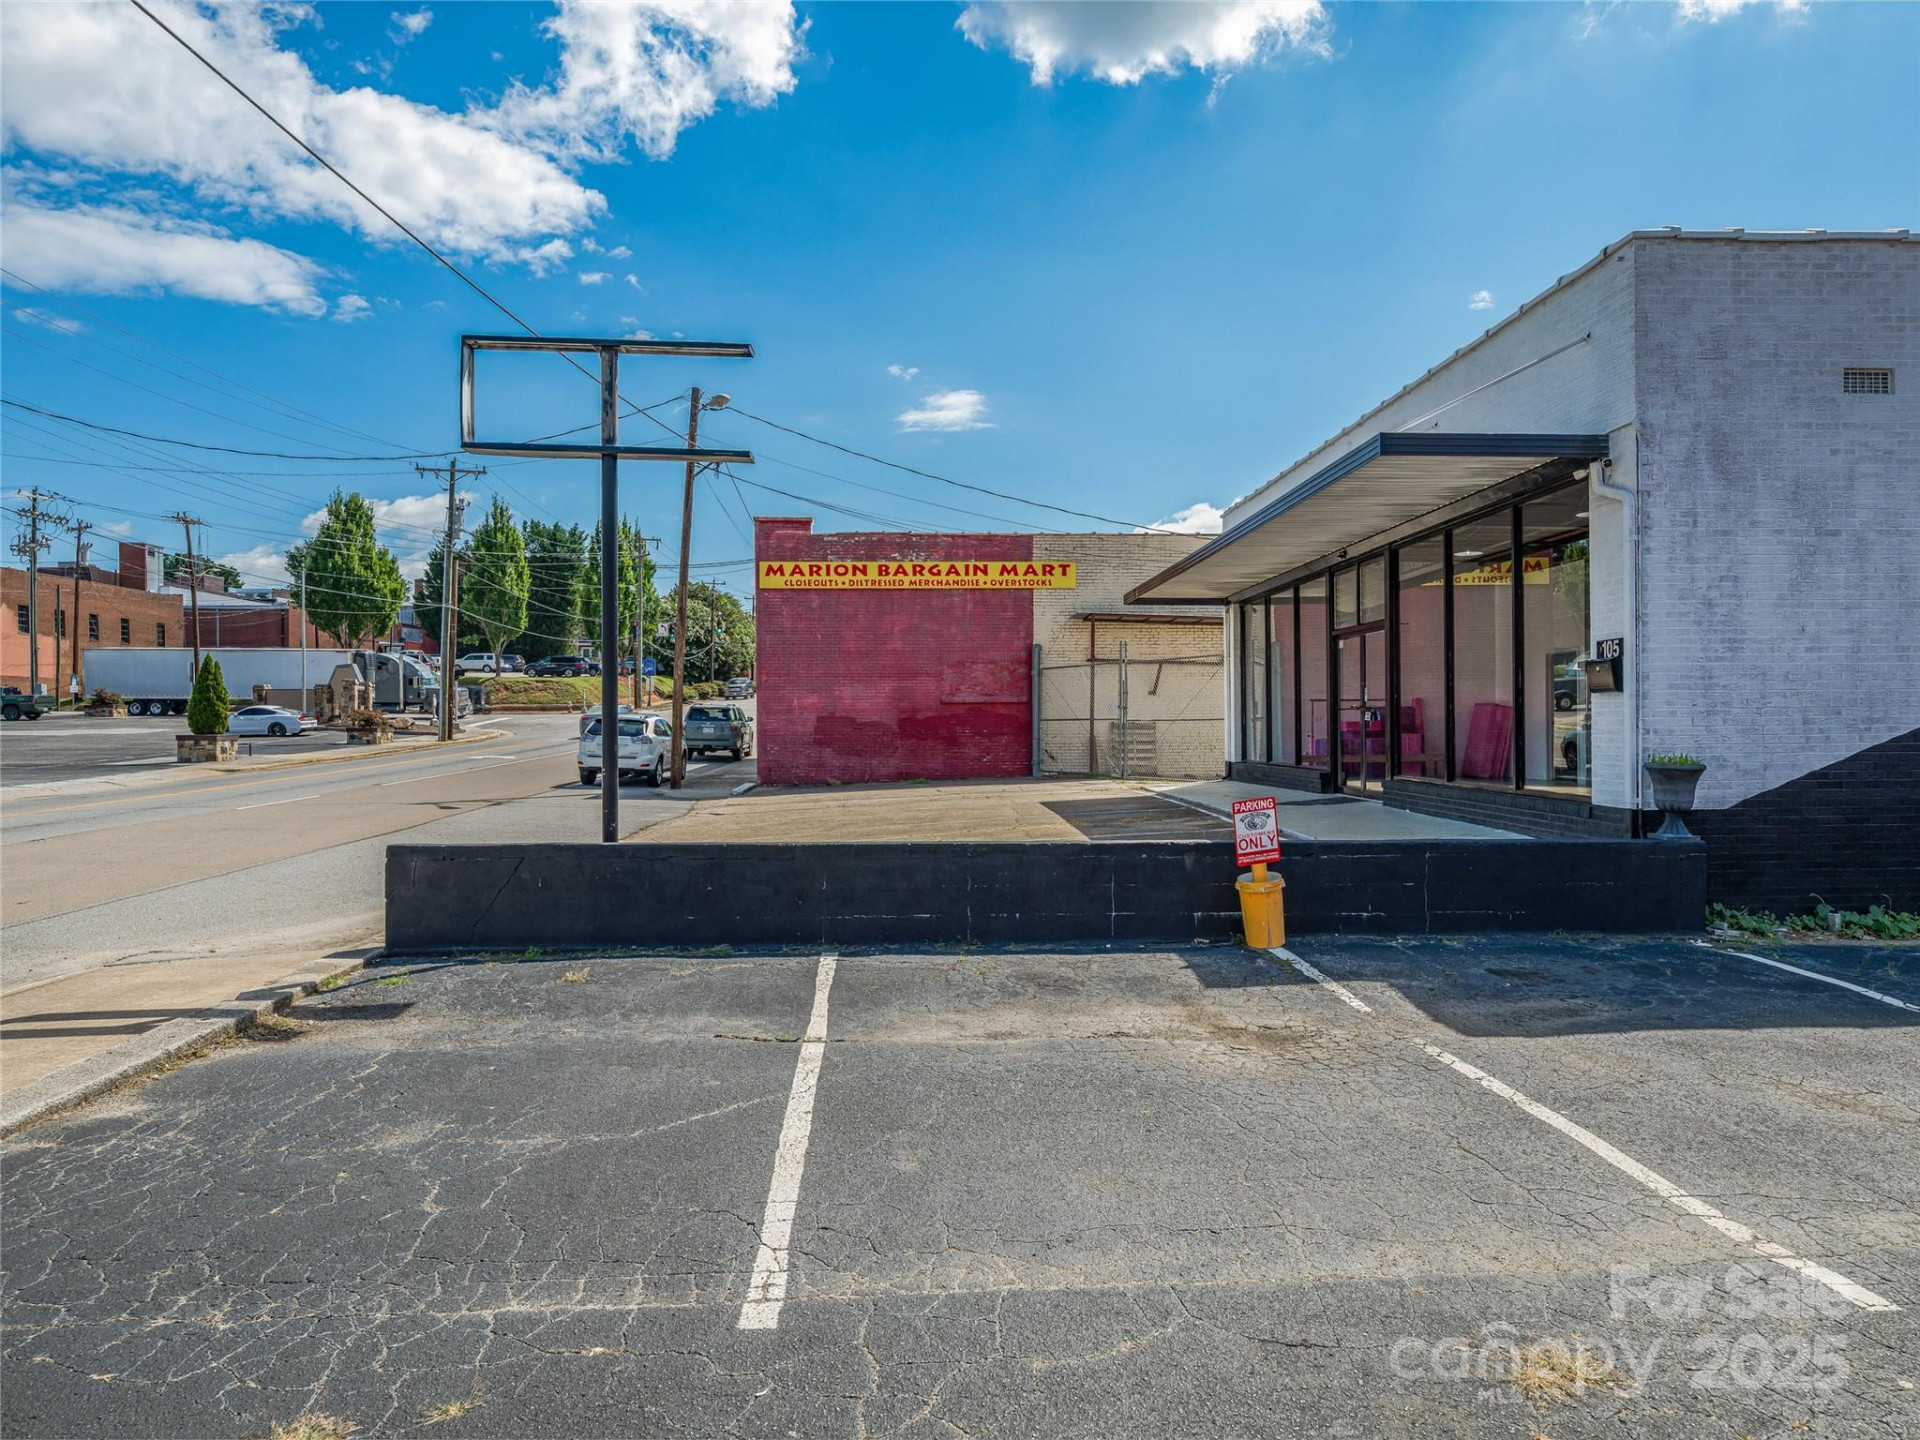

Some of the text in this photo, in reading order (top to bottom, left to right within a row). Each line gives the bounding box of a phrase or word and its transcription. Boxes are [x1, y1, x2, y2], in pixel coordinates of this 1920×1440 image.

[764, 564, 1071, 577] MARION BARGAIN MART
[784, 579, 1053, 587] CLOSEOUTS DISTRESSED MERCHANDISE OVERSTOCKS
[1602, 639, 1620, 658] 105
[1234, 798, 1274, 813] PARKING
[1238, 834, 1276, 851] ONLY
